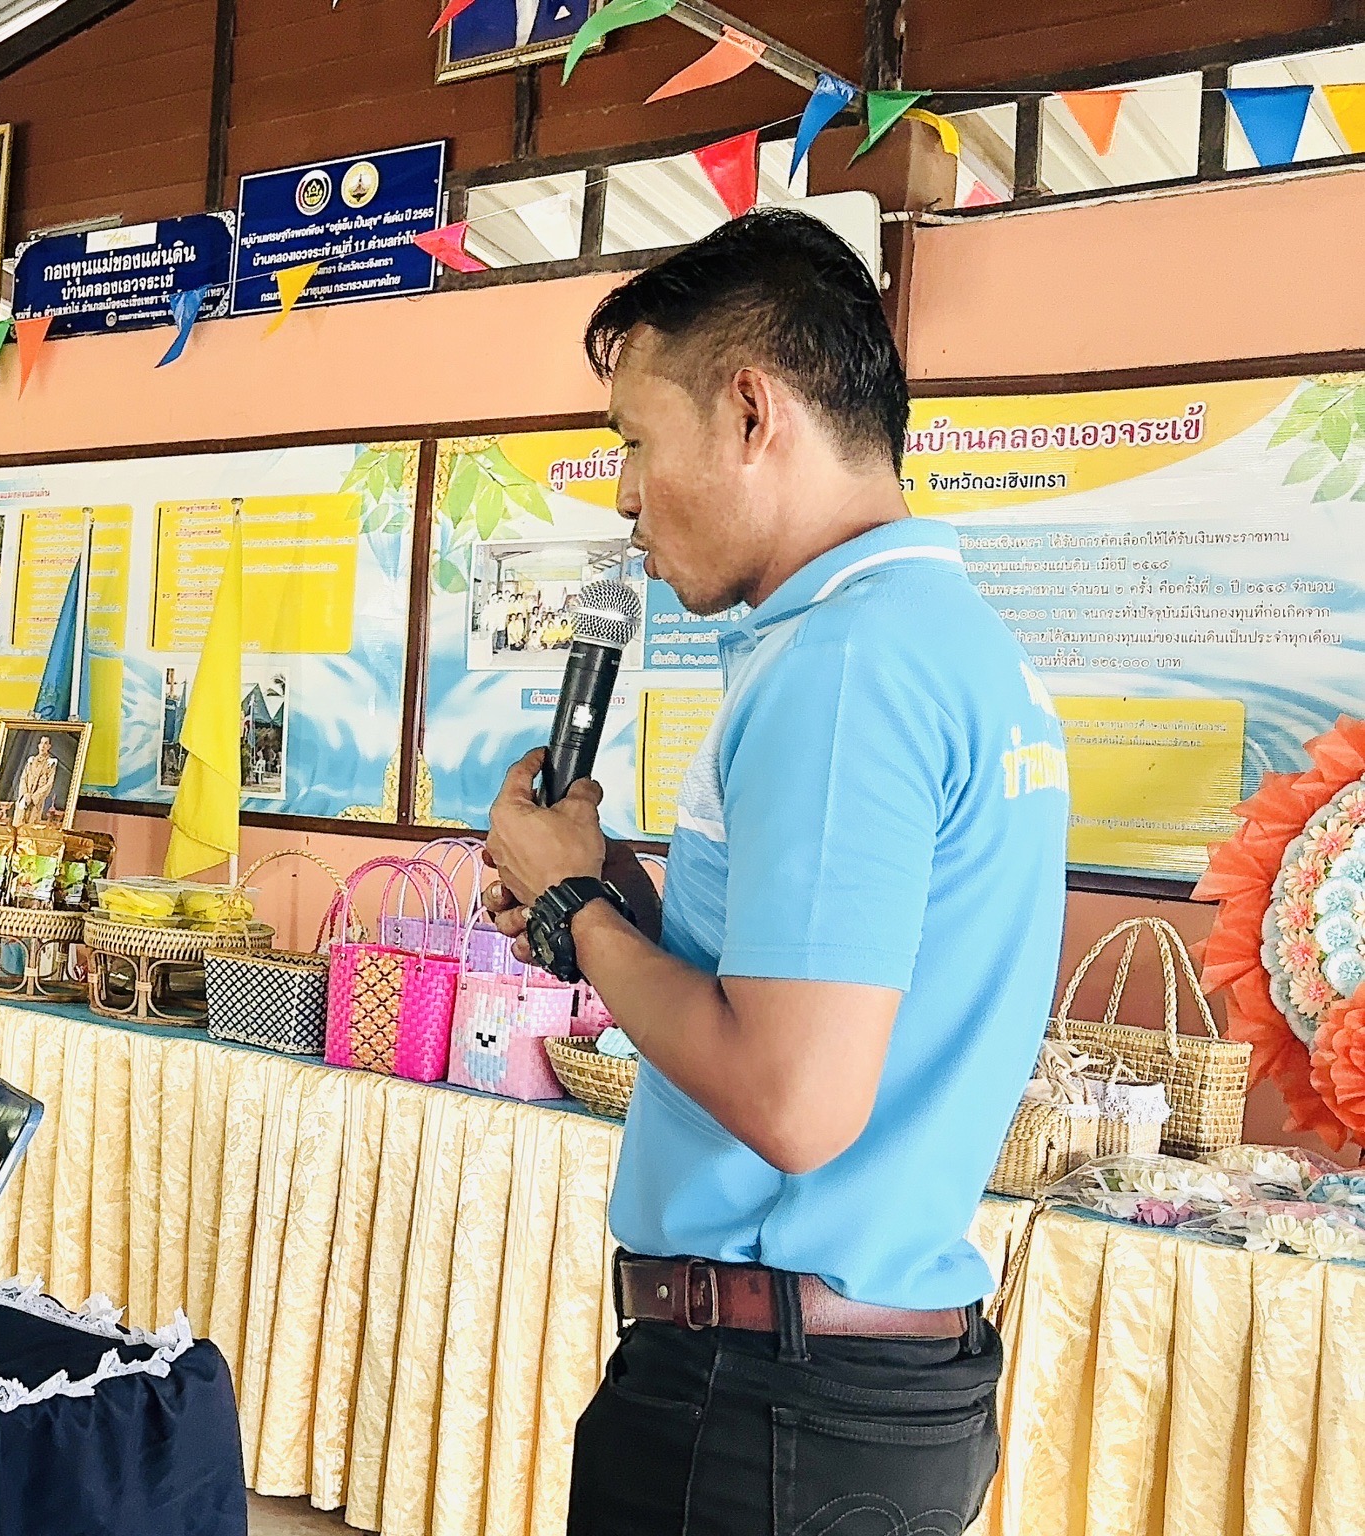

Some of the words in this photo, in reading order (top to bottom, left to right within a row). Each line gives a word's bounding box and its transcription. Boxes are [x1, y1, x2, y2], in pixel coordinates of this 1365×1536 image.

[412, 207, 435, 220] 2565
[354, 240, 366, 252] 11
[43, 239, 197, 285] กองทุนแม่ของแผ่นดิน
[61, 267, 176, 300] บ้านคลองเอวจระเข้
[928, 471, 1066, 491] จังหวัดฉะเชิงเทรา
